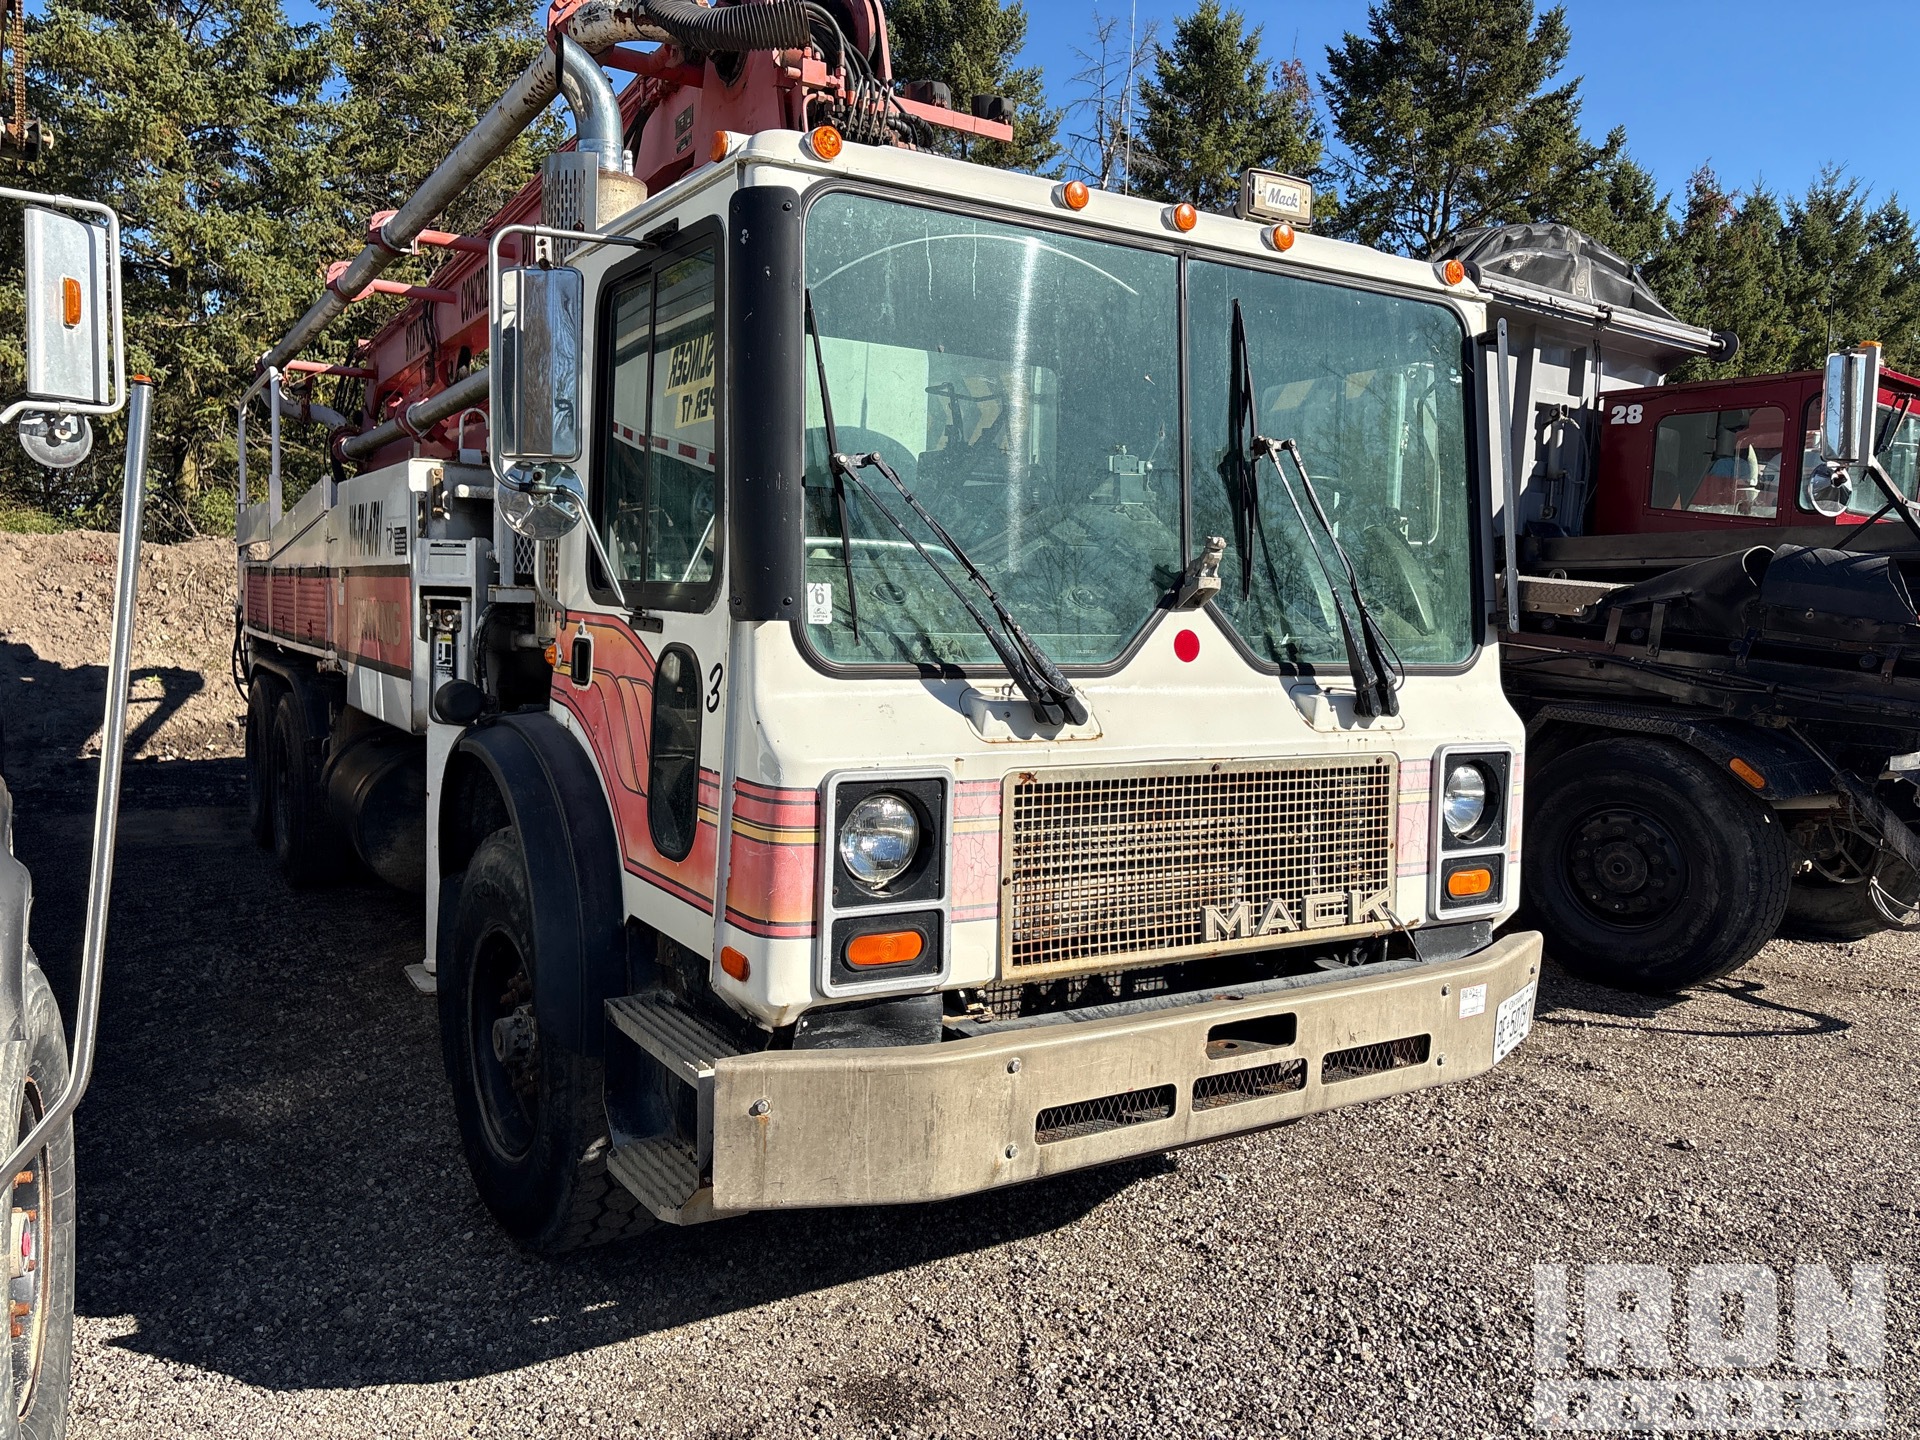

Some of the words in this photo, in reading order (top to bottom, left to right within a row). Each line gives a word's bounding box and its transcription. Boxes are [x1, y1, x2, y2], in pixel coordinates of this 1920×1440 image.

[1267, 187, 1298, 208] Mack
[461, 264, 489, 323] CONCRE
[1611, 404, 1644, 425] 28
[815, 588, 825, 605] 6
[706, 662, 724, 713] 3
[1200, 886, 1392, 943] MACK
